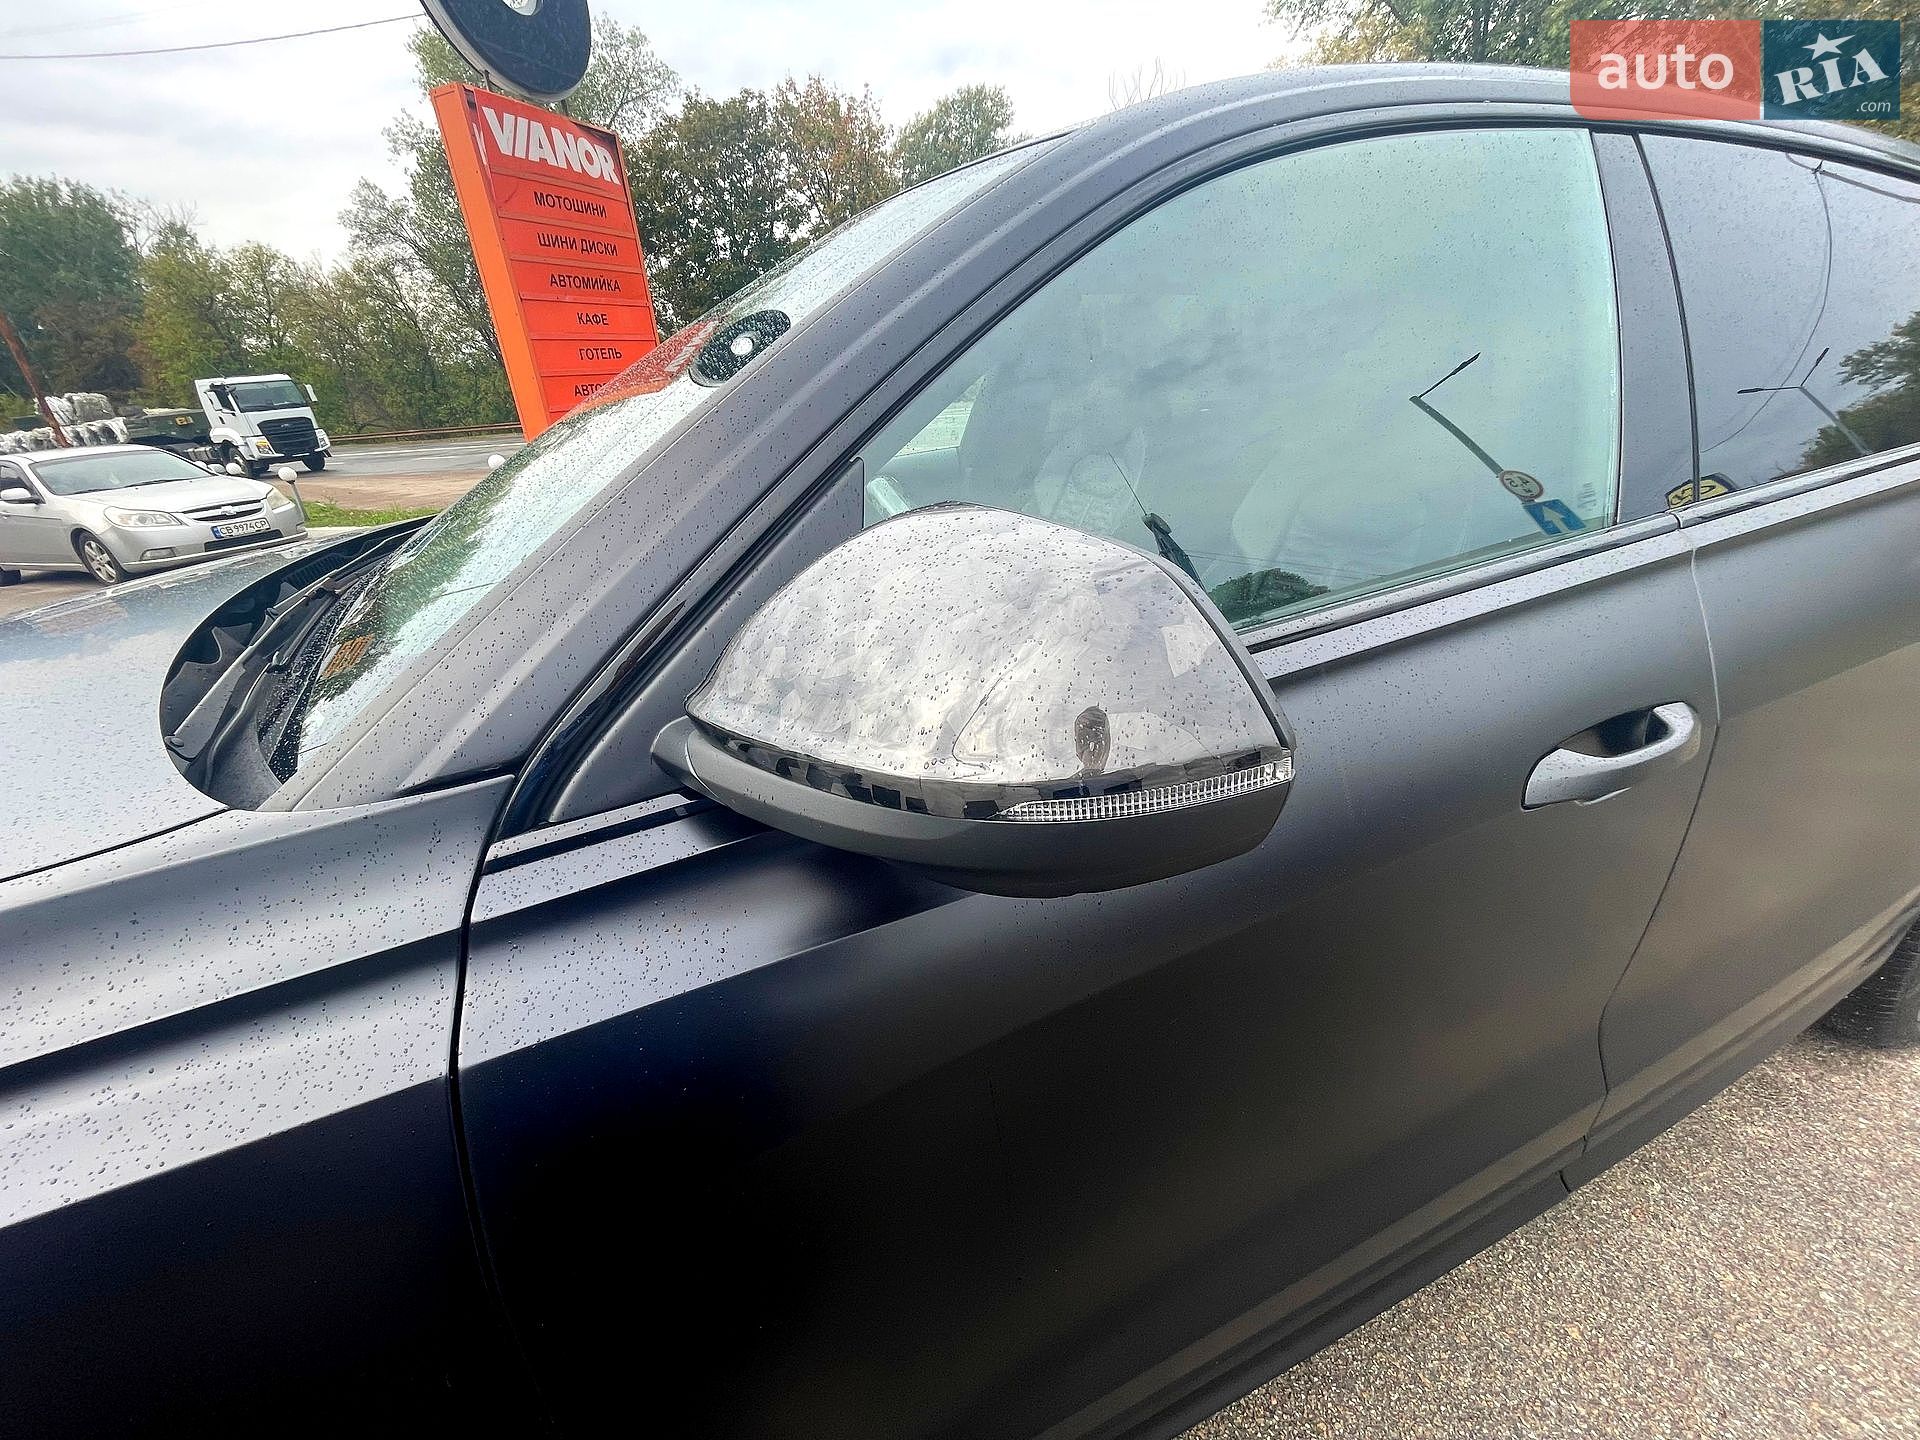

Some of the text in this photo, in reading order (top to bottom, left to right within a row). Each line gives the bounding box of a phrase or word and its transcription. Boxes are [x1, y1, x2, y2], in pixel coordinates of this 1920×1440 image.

[481, 106, 621, 185] VIANOR
[533, 191, 607, 218] МОТОШИНИ
[537, 232, 618, 256] ШИНИ ДИСКИ
[550, 273, 621, 292] АВТОМИЙКА
[577, 312, 609, 326] КАФЕ
[579, 347, 622, 360] ГОТЕЛЬ
[574, 382, 606, 397] АВТО
